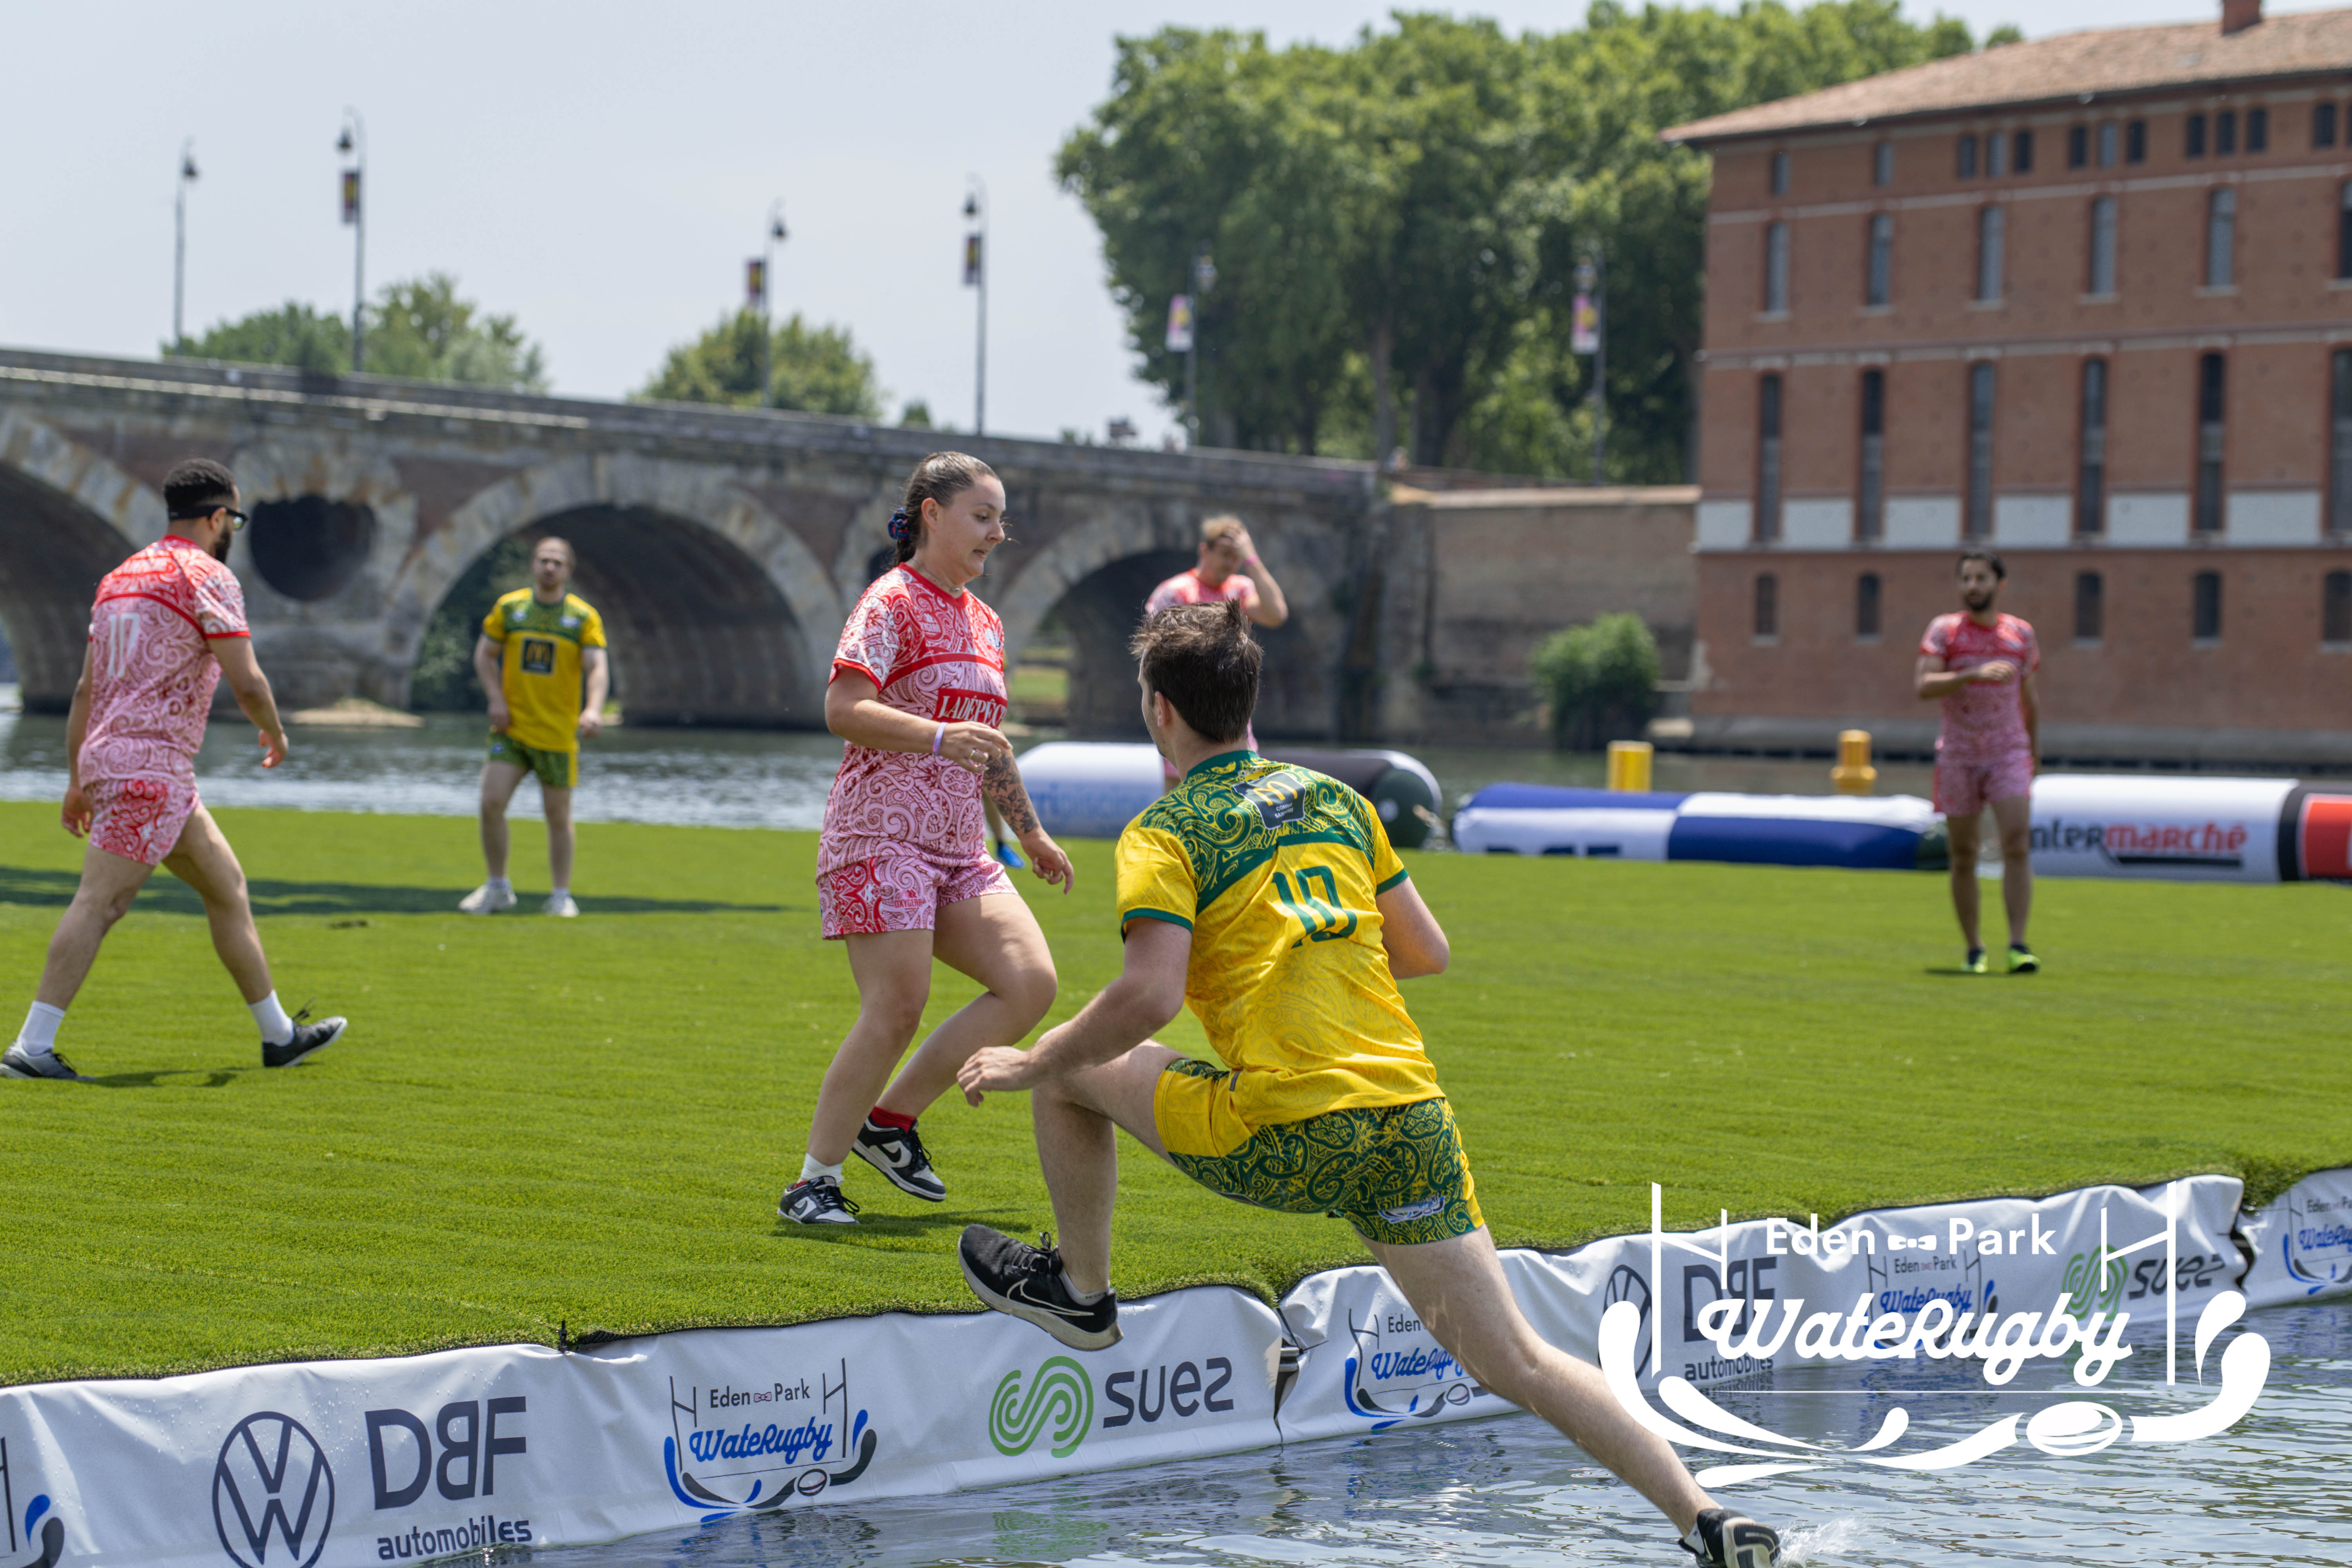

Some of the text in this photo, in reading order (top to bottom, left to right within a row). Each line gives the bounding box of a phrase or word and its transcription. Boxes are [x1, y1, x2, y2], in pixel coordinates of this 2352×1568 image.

[2031, 818, 2247, 851] ntermarché
[895, 898, 922, 908] OXYGEAR
[1272, 866, 1357, 949] 10
[1894, 1254, 1957, 1274] Eden Park
[1388, 1314, 1420, 1333] Eden
[710, 1378, 810, 1408] Eden Park
[365, 1396, 526, 1510] DBF
[689, 1416, 833, 1465] WateRugby
[377, 1515, 532, 1560] automobiles
